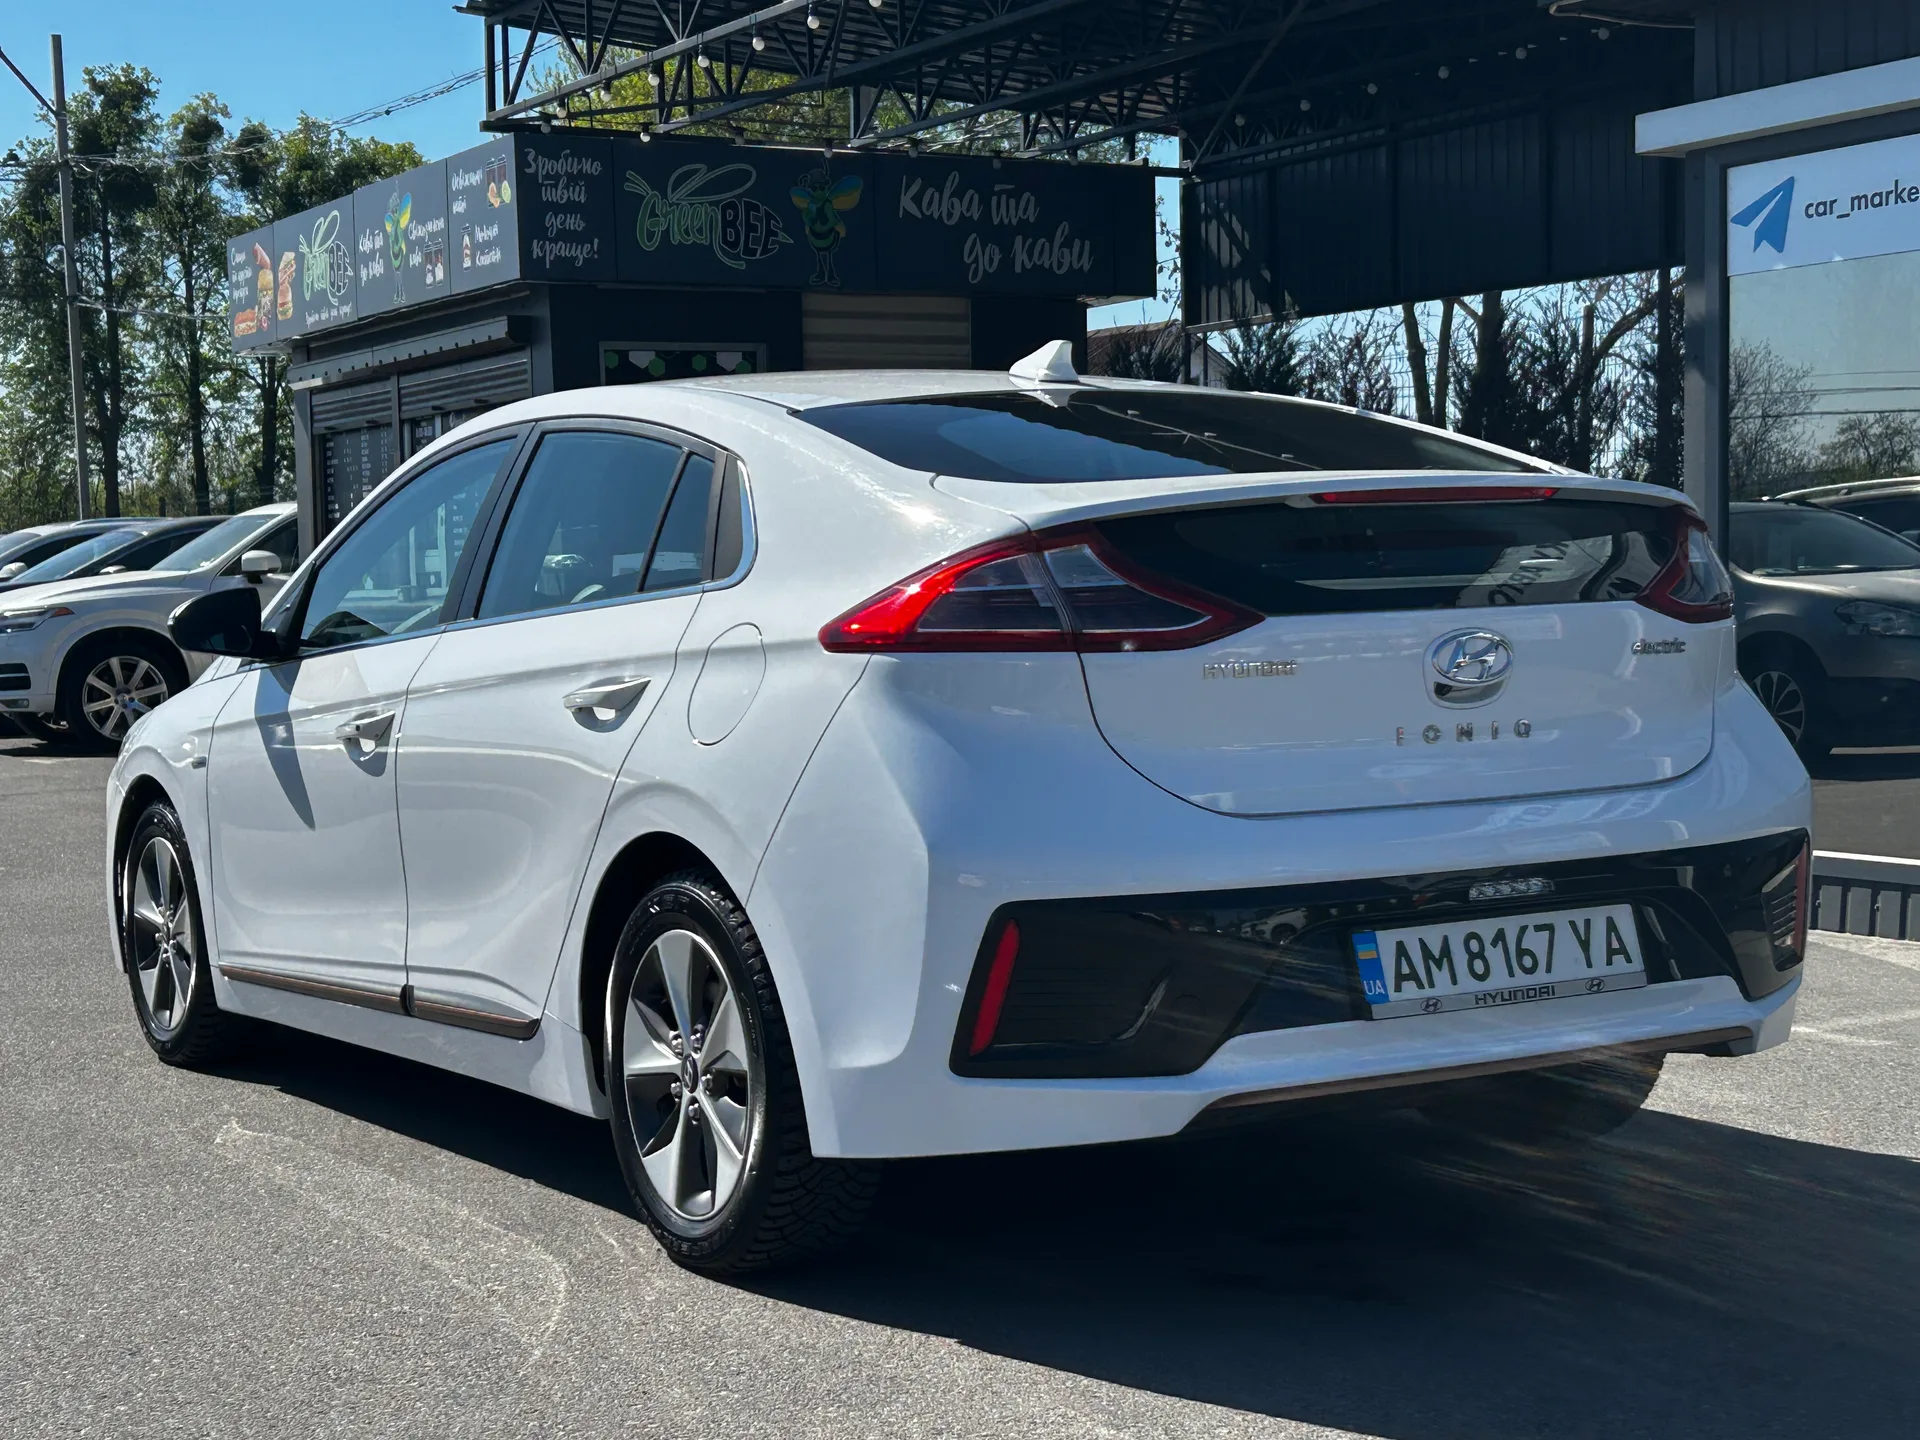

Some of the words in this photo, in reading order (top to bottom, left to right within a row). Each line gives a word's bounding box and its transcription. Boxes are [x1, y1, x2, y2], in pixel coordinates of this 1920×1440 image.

[541, 175, 588, 204] твій
[899, 170, 983, 226] Кава
[990, 184, 1040, 226] та
[545, 211, 587, 238] день
[530, 237, 600, 269] краще!
[963, 232, 1002, 284] до
[1010, 221, 1094, 275] кави
[1630, 637, 1686, 655] electric
[1202, 658, 1298, 680] HYUNDAI
[1395, 717, 1532, 747] IONIQ
[1568, 915, 1633, 969] YA
[1363, 978, 1386, 996] UA
[1474, 985, 1556, 1006] HYUNDAI
